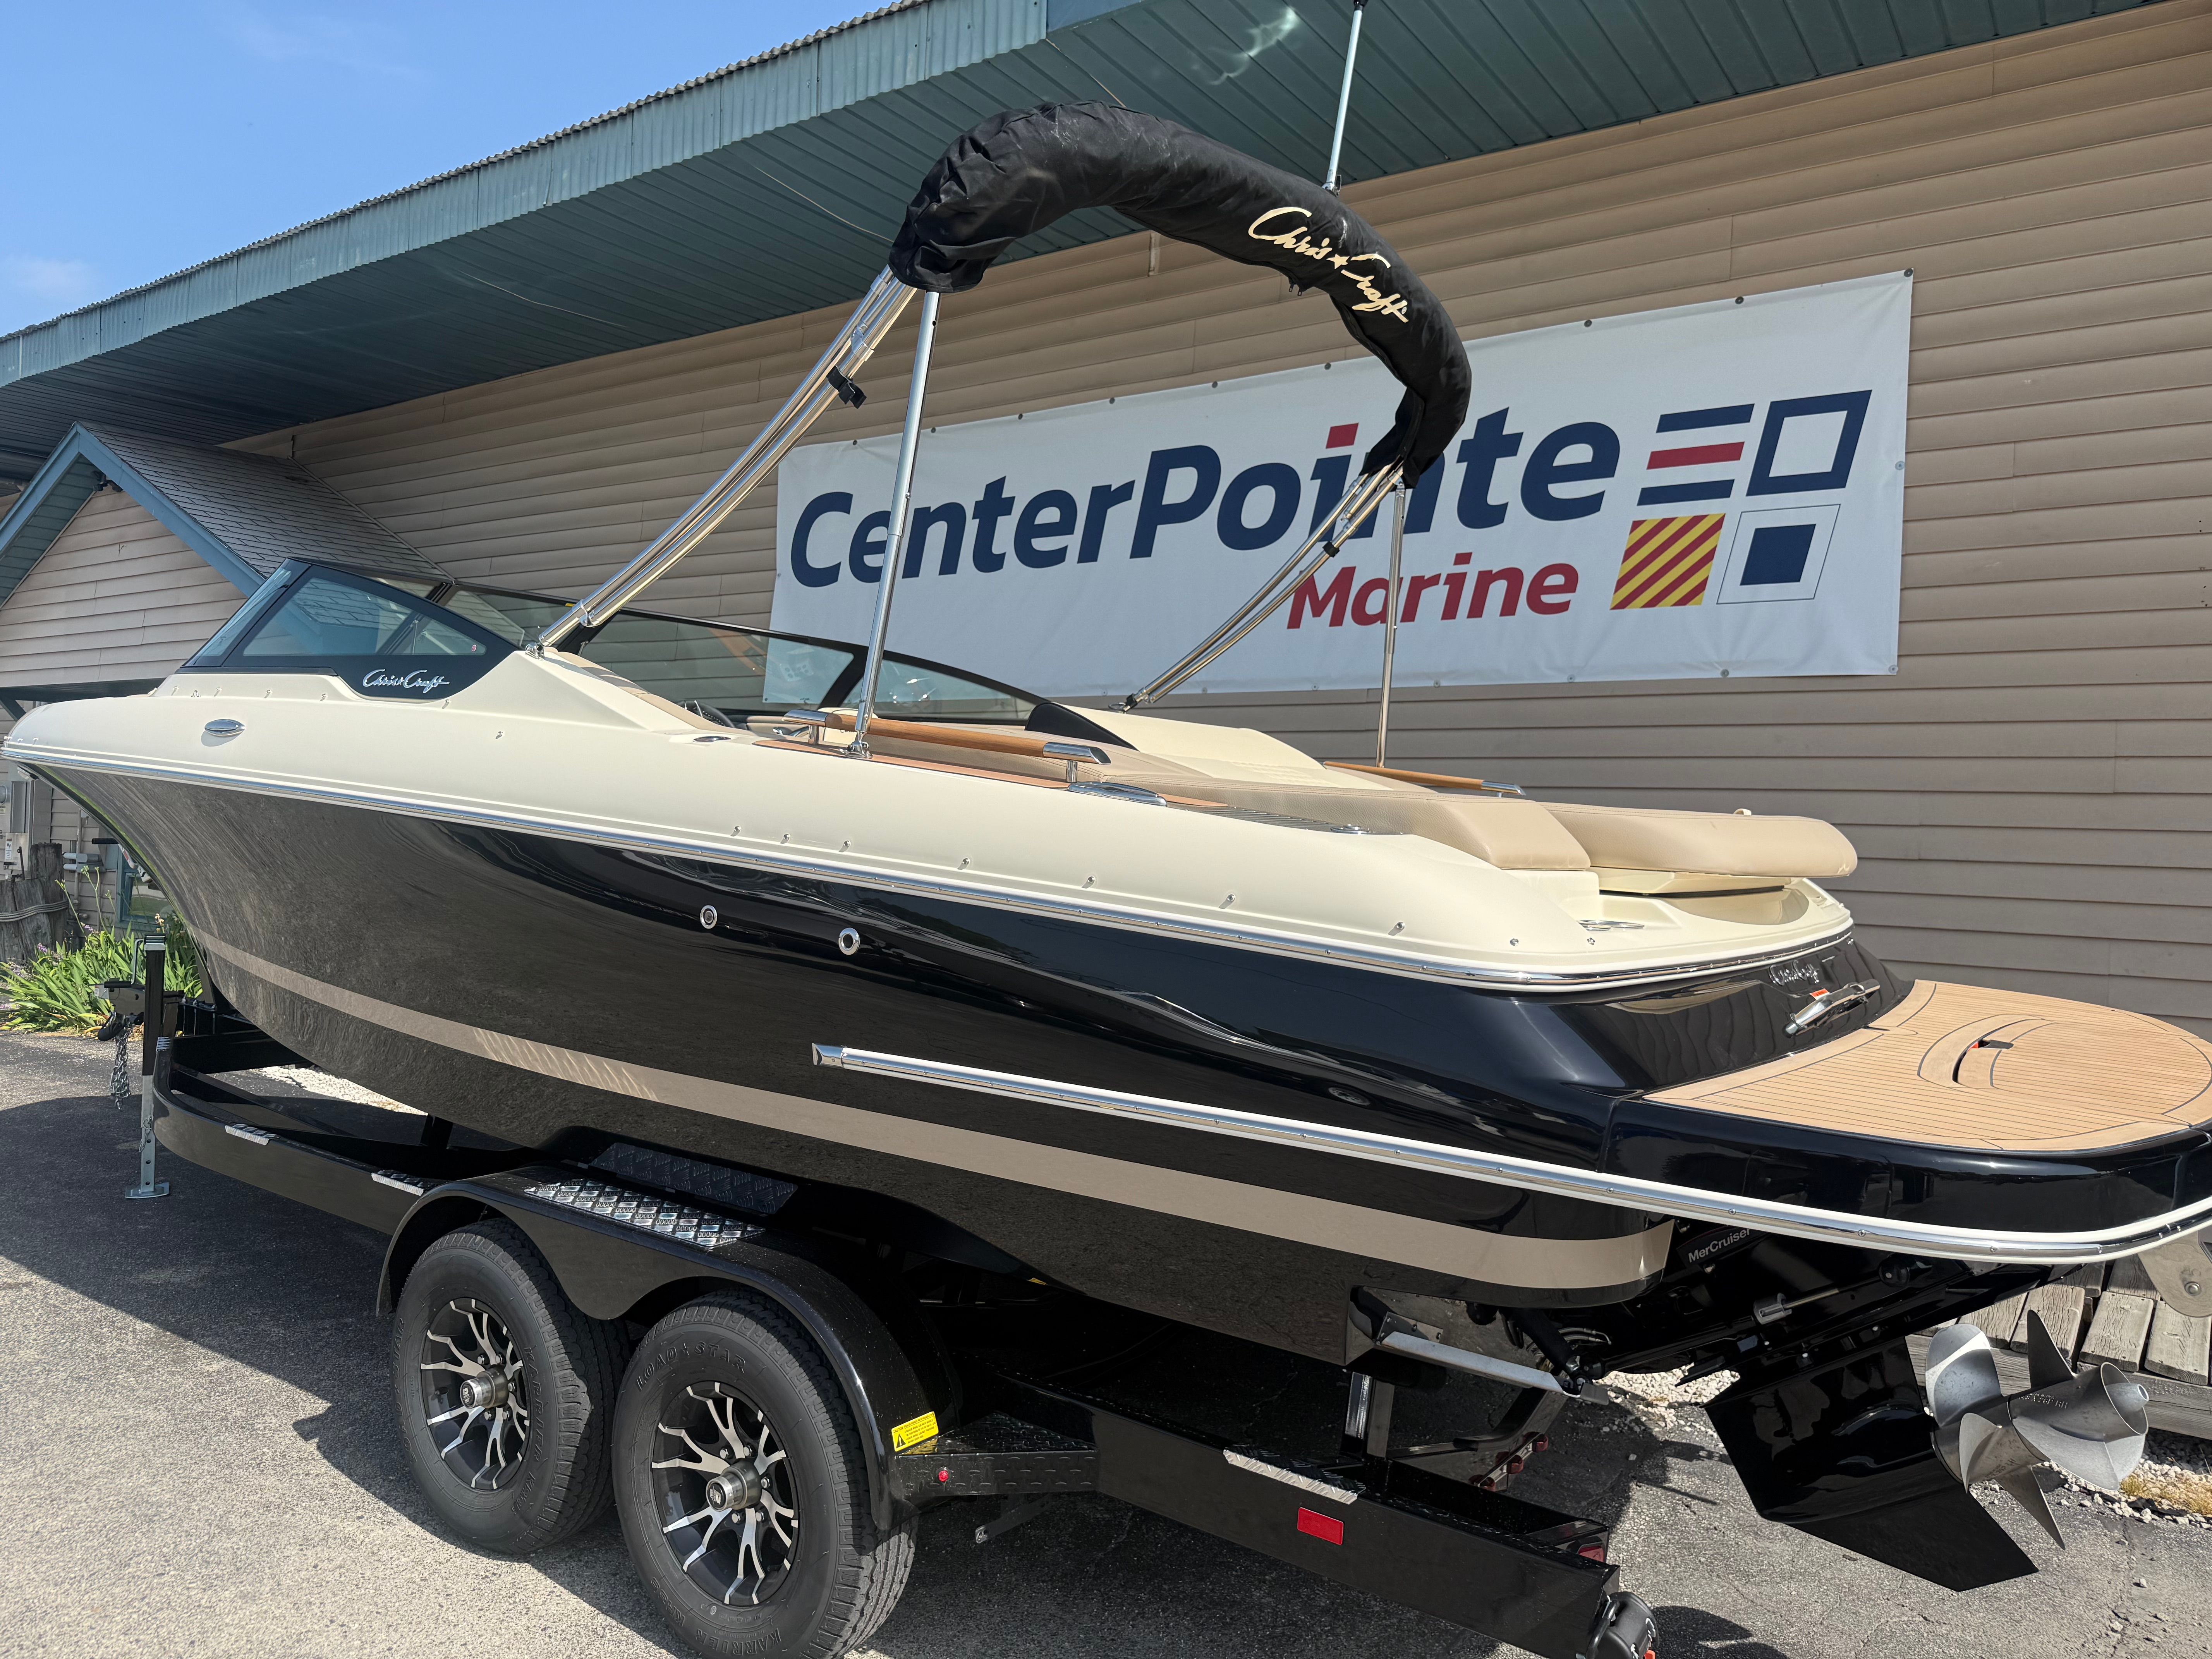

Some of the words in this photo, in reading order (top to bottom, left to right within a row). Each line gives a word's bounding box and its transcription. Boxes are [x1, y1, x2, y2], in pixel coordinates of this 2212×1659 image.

[791, 407, 1620, 587] CenterPointe
[1286, 552, 1578, 629] Marine
[1688, 1228, 1751, 1263] MerCruiser
[636, 1346, 678, 1392] LOAD
[694, 1341, 746, 1374] STAR
[523, 1347, 544, 1462] KARRIER
[696, 1628, 782, 1656] KARRIER
